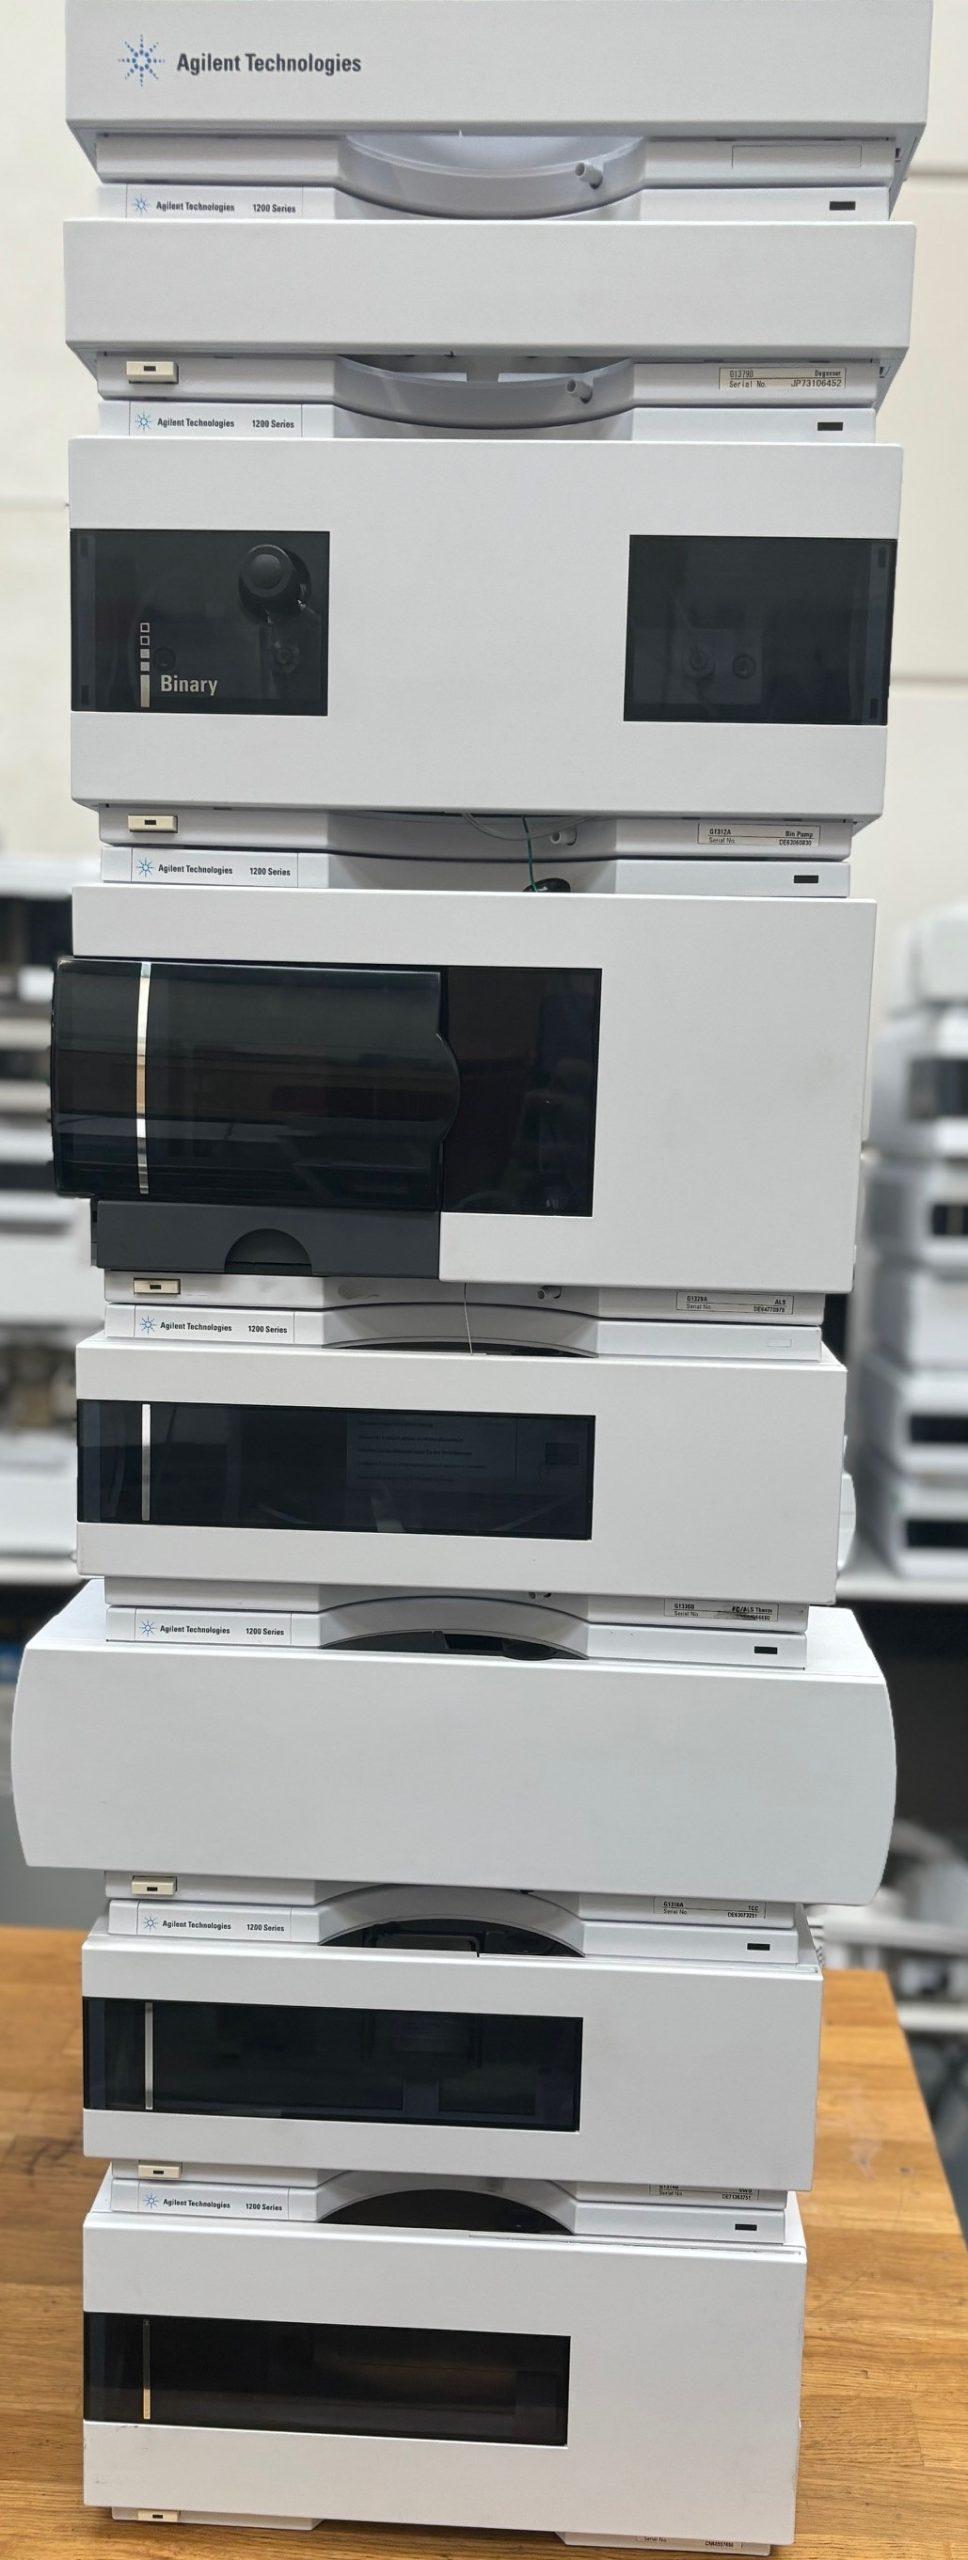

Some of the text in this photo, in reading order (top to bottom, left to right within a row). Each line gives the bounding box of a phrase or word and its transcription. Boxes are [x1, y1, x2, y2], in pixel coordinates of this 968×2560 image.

[176, 53, 362, 76] Agilent Technologies
[156, 201, 235, 213] Agilent Technologies
[252, 204, 296, 213] 1200 Series
[729, 380, 753, 388] Serial
[790, 380, 841, 388] JP73106452
[157, 418, 235, 429] Agilent Technologies
[252, 420, 294, 429] 1200 Series
[161, 674, 218, 696] Binary
[796, 831, 813, 839] Pump
[158, 864, 233, 875] Agilent Technologies
[250, 867, 291, 876] 1200 Series
[160, 1322, 232, 1332] Agilent Technologies
[248, 1325, 288, 1334] 1200 Series
[160, 1625, 230, 1635] Agilent Technologies
[262, 1628, 284, 1636] Series
[162, 1920, 231, 1931] Agilent Technologies
[246, 1923, 284, 1932] 1200 Series
[163, 2198, 231, 2209] Agilent Technologies
[262, 2203, 282, 2211] Series
